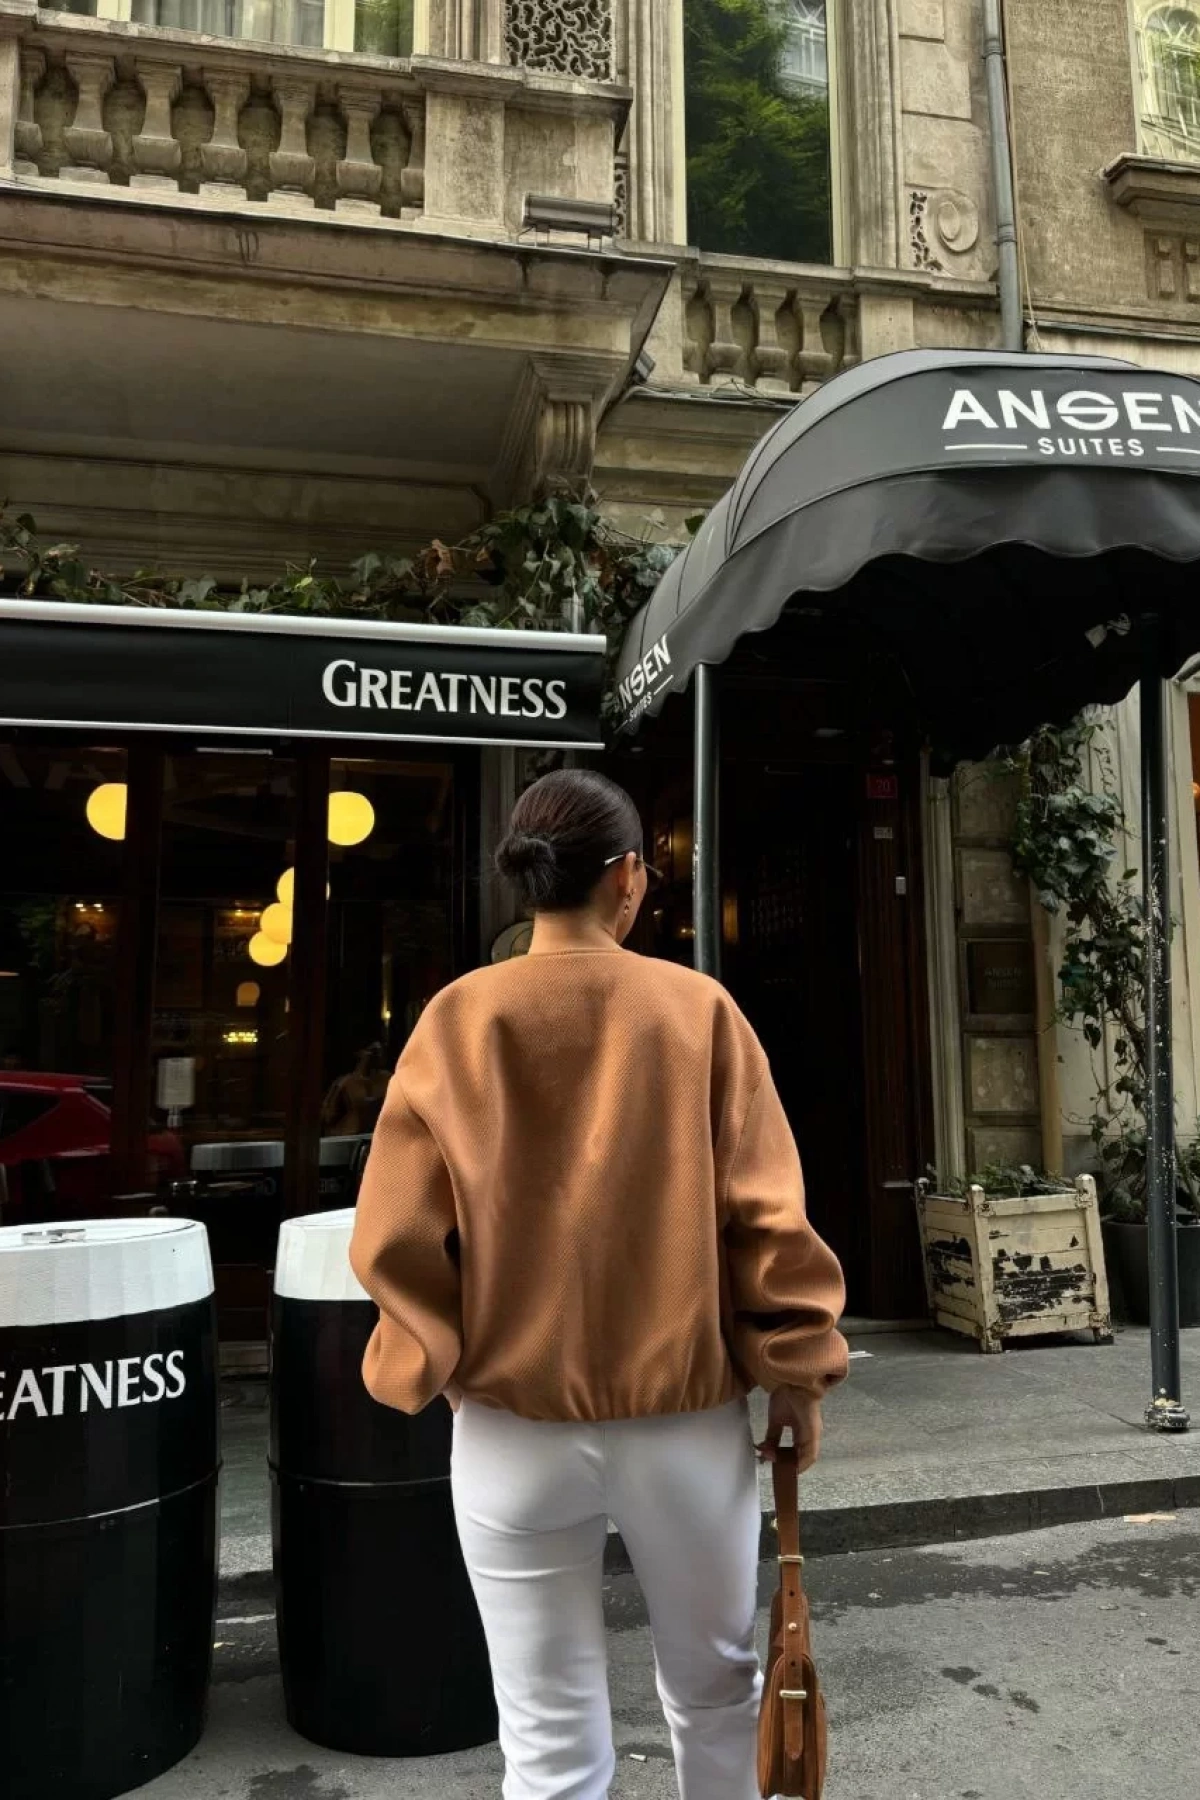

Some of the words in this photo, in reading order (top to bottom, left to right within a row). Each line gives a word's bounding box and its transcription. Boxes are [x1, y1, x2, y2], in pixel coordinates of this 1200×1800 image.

[1038, 437, 1144, 456] SUITES
[322, 659, 567, 719] GREATNESS
[617, 633, 671, 711] NSEN
[0, 1350, 187, 1420] ATNESS
